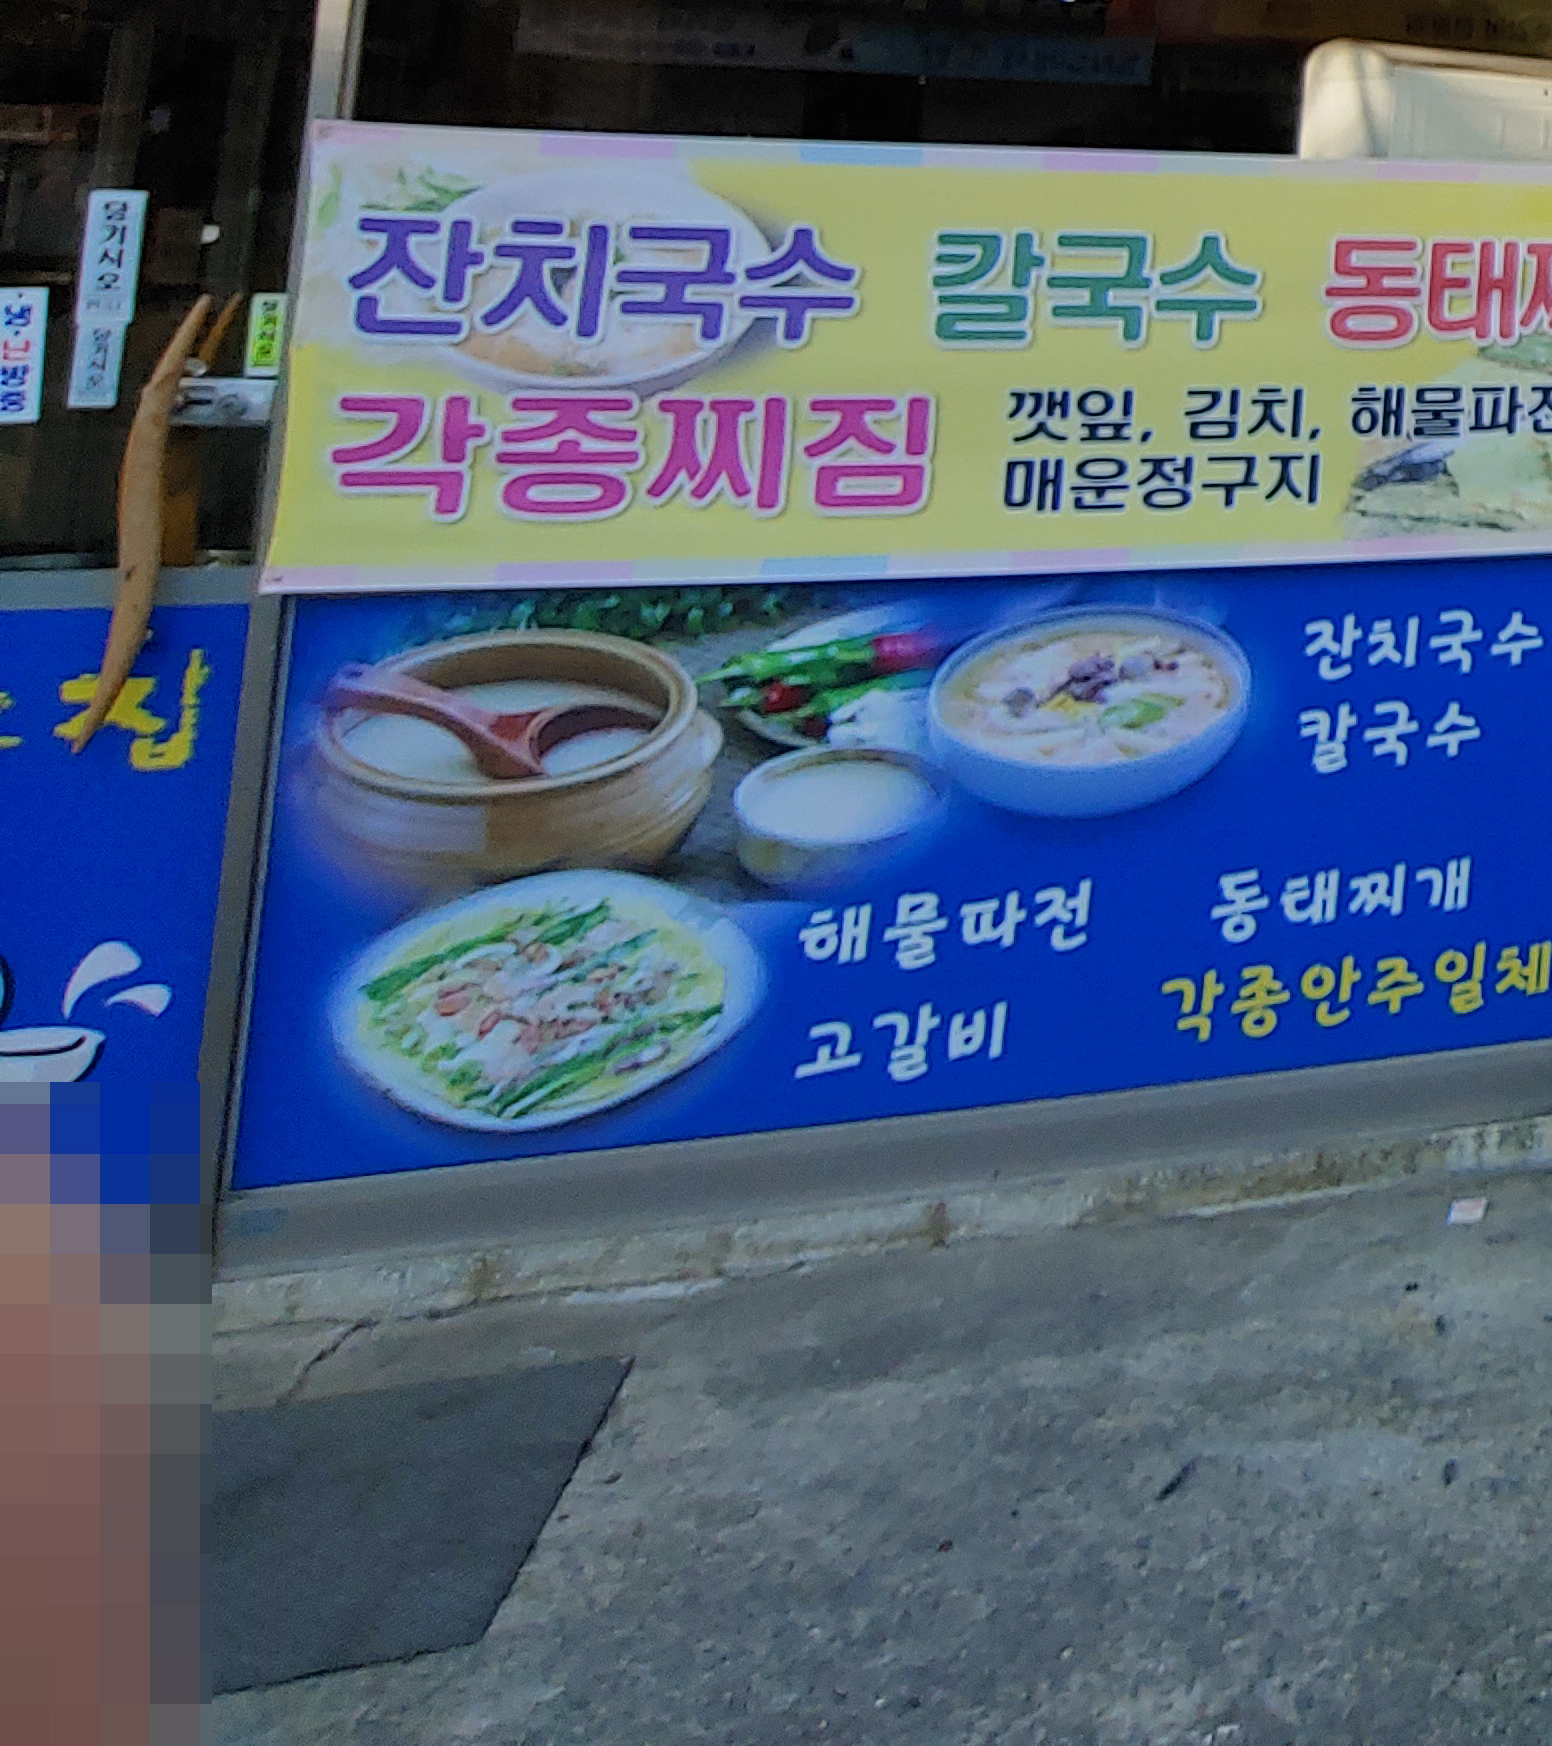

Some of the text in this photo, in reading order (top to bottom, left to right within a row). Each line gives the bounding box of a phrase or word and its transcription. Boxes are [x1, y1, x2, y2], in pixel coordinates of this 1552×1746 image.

[346, 211, 864, 347] 잔치국수
[928, 227, 1263, 348] 칼국수
[328, 390, 938, 524] 각종찌짐
[1004, 386, 1154, 448] 깻잎,
[1183, 385, 1324, 446] 김치,
[1002, 452, 1324, 516] 매운정구지
[1303, 608, 1546, 682] 잔치국수
[1298, 700, 1483, 775] 칼국수
[1208, 855, 1474, 945] 동태찌개
[794, 1000, 1008, 1083] 고갈비
